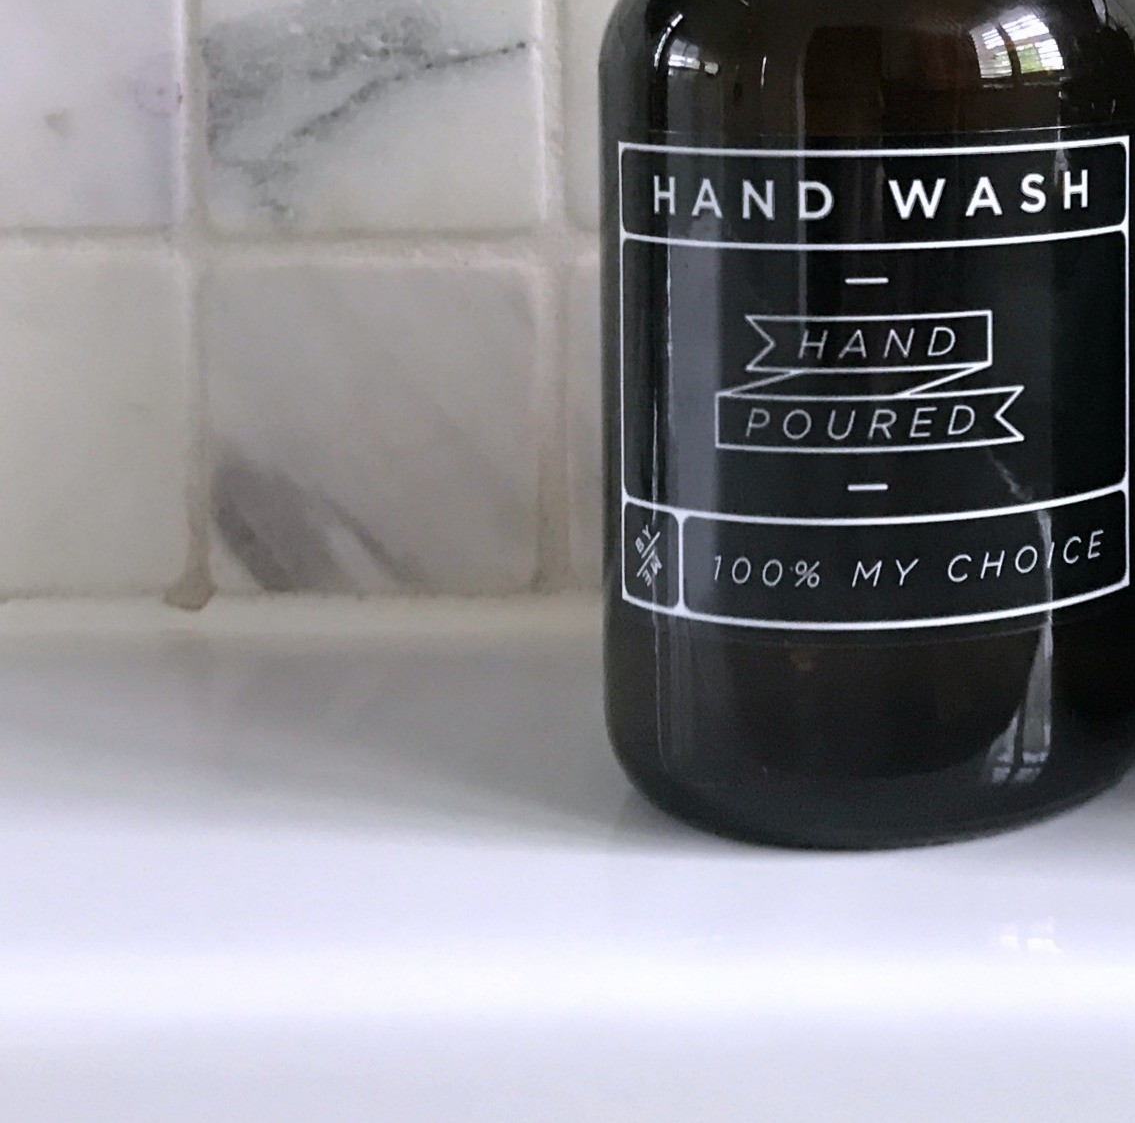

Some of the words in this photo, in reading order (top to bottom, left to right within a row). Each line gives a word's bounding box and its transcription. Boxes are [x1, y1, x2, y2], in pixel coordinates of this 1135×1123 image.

[653, 175, 834, 219] HAND
[888, 170, 1089, 219] WASH
[799, 326, 957, 359] HAND
[746, 405, 977, 440] POURED
[713, 555, 821, 588] 100%
[852, 558, 919, 587] MY
[947, 529, 1104, 582] CHOICE
